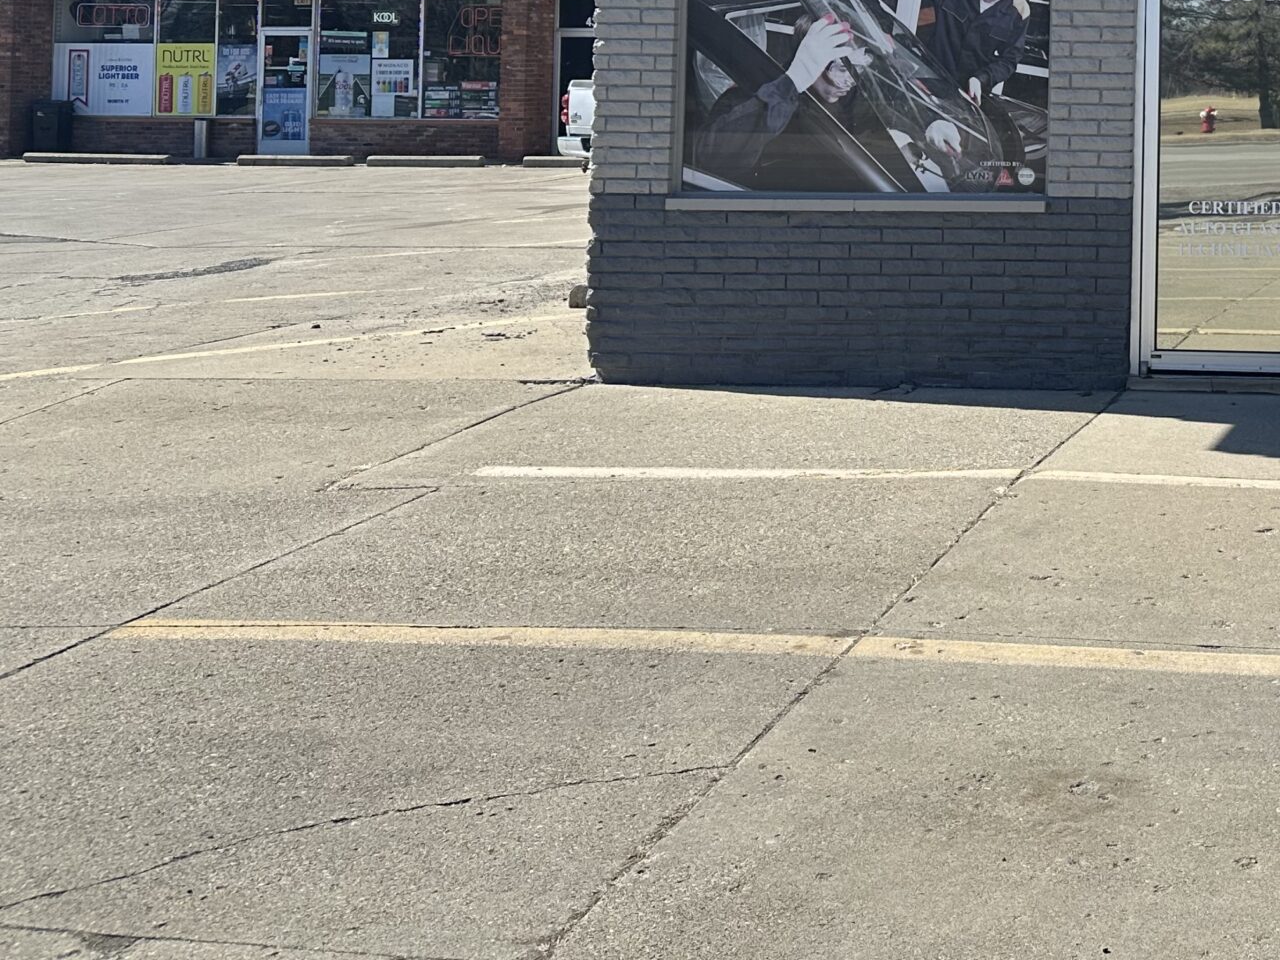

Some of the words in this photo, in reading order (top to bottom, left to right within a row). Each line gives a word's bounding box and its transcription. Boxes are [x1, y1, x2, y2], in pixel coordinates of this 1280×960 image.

[373, 12, 398, 23] KOOL
[460, 7, 501, 28] OPE
[450, 34, 501, 55] LIQU
[100, 64, 138, 72] SUPERIOR
[98, 72, 120, 80] LIGHT
[121, 72, 139, 80] BEER
